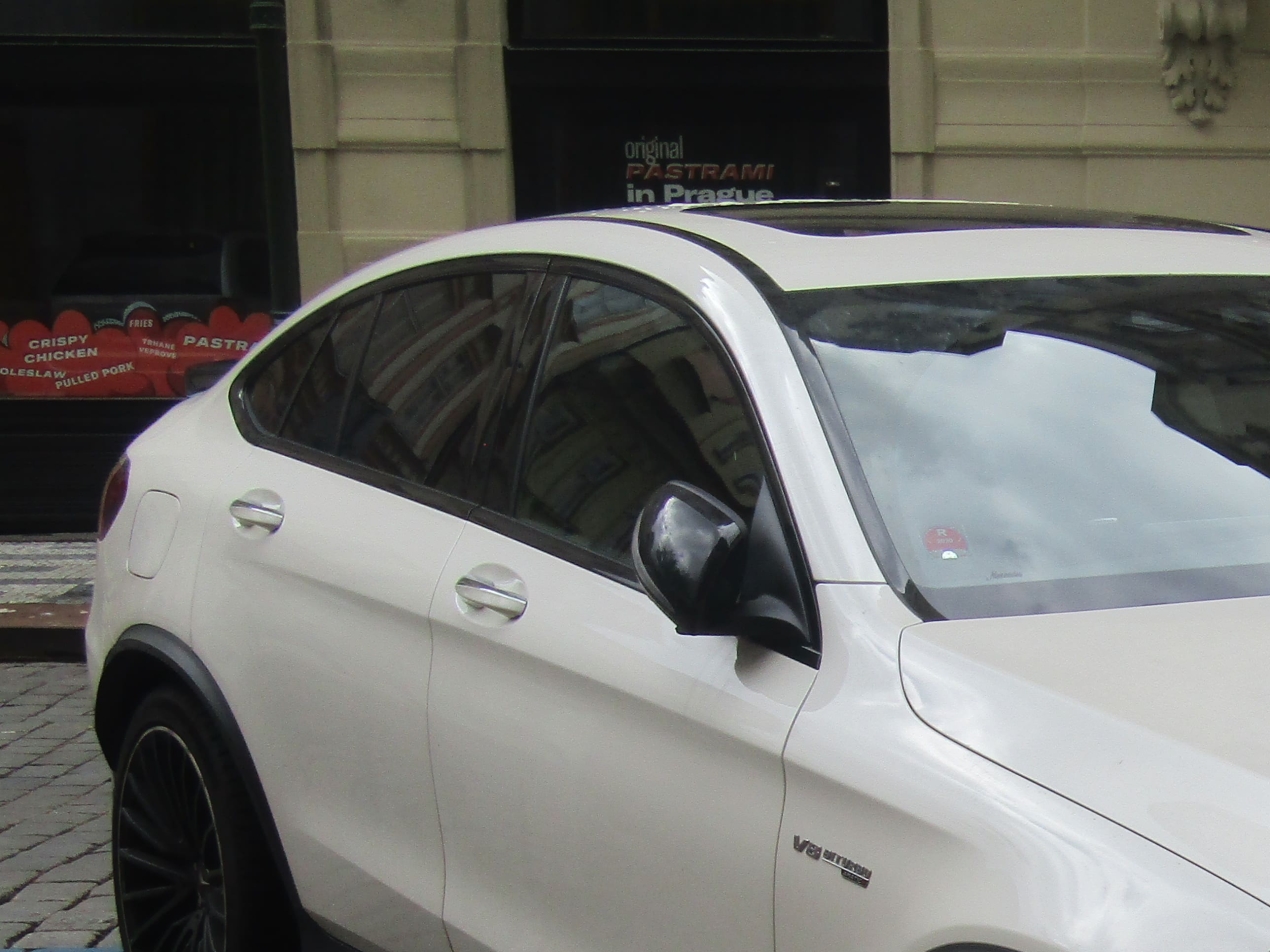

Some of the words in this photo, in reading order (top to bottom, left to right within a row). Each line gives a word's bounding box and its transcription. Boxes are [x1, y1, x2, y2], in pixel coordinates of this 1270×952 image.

[625, 135, 684, 165] original
[626, 163, 775, 180] PASTRAMI
[626, 183, 655, 203] in
[663, 183, 775, 203] Prague
[129, 319, 154, 329] FRIES
[28, 335, 89, 350] CRISPY
[24, 348, 98, 364] CHICKEN
[0, 367, 67, 379] OLESLAW
[55, 371, 99, 390] PULLED
[101, 362, 135, 378] PORK
[936, 528, 948, 537] R
